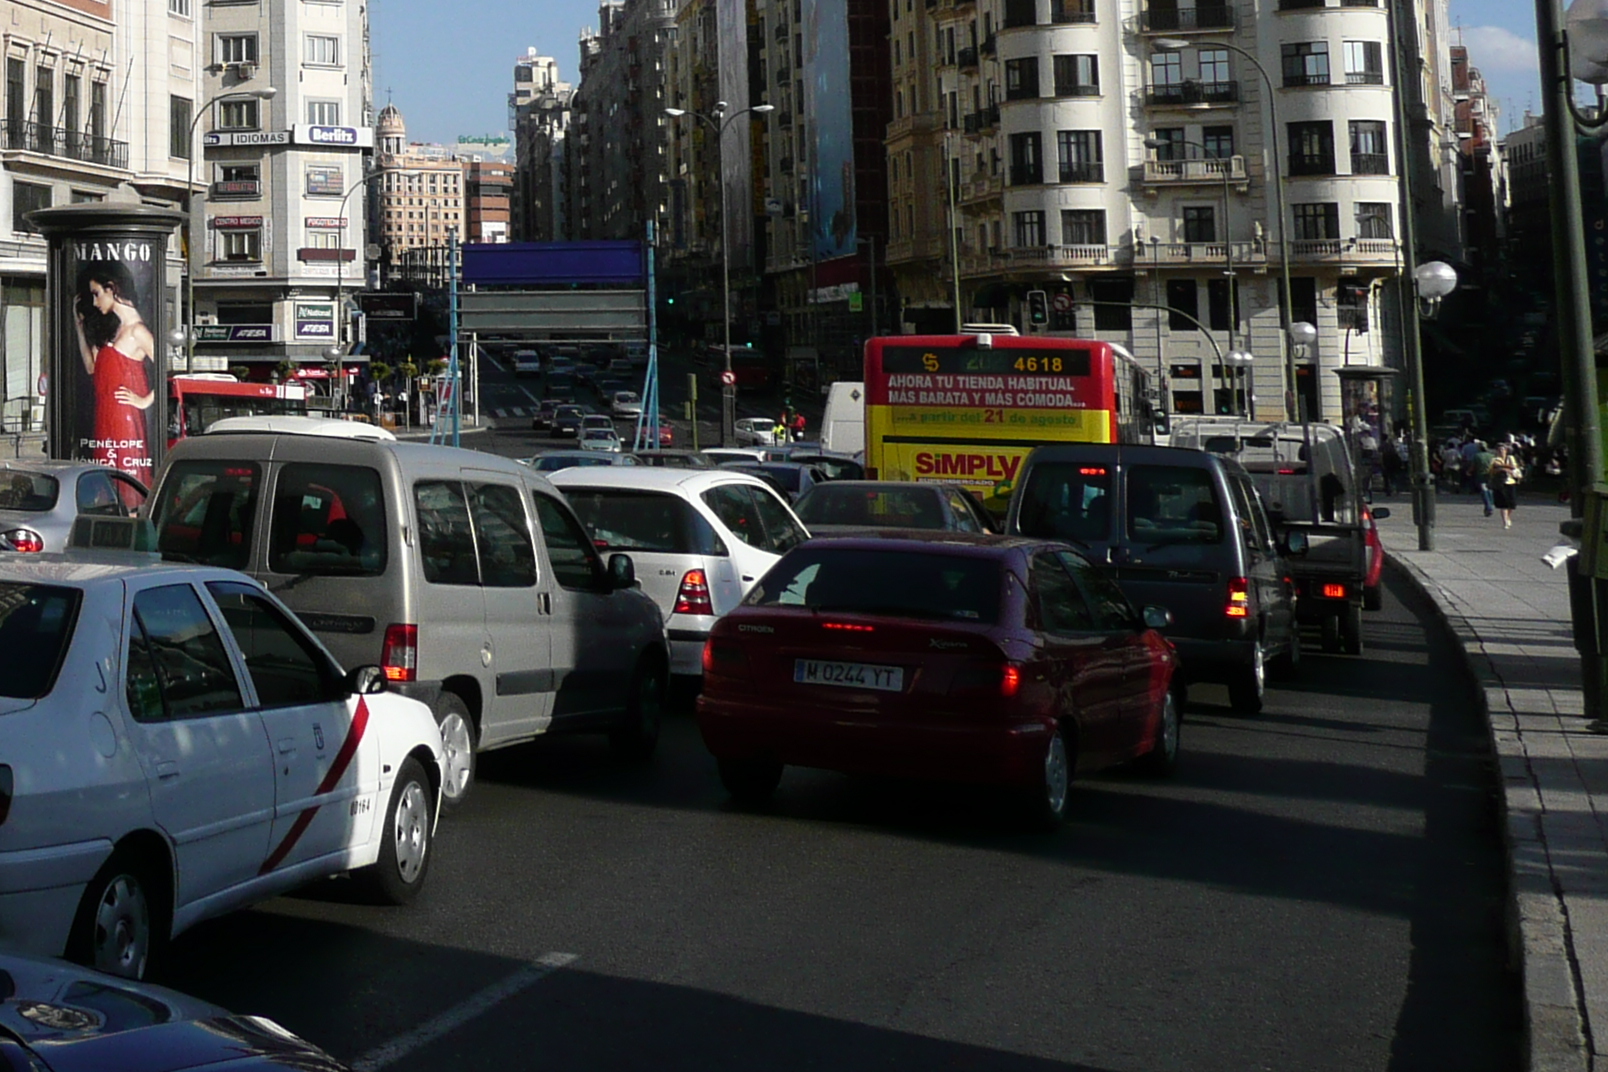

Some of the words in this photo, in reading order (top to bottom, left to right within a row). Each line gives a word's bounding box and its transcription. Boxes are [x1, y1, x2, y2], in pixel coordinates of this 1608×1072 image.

[236, 133, 285, 144] IDIOMAS
[312, 129, 354, 143] Berlitz
[73, 243, 150, 261] MANGO
[307, 309, 331, 317] National
[236, 329, 267, 338] ATESA
[301, 324, 330, 333] ATESA
[1014, 357, 1063, 372] 4618
[888, 375, 933, 389] AHORA
[936, 376, 954, 389] TU
[957, 376, 1005, 390] TIENDA
[1008, 377, 1075, 391] HABITUAL
[888, 389, 916, 404] MÁS
[919, 391, 970, 405] BARATA
[973, 392, 983, 405] Y
[985, 390, 1013, 406] MÁS
[920, 412, 956, 424] partir
[961, 412, 981, 424] del
[984, 409, 1005, 424] 21
[1009, 413, 1026, 425] de
[1030, 414, 1076, 426] agosto
[106, 449, 117, 459] &
[94, 660, 108, 694] J
[807, 662, 818, 680] M
[823, 664, 866, 685] 0244
[872, 668, 895, 686] YT
[350, 798, 370, 817] 00164
